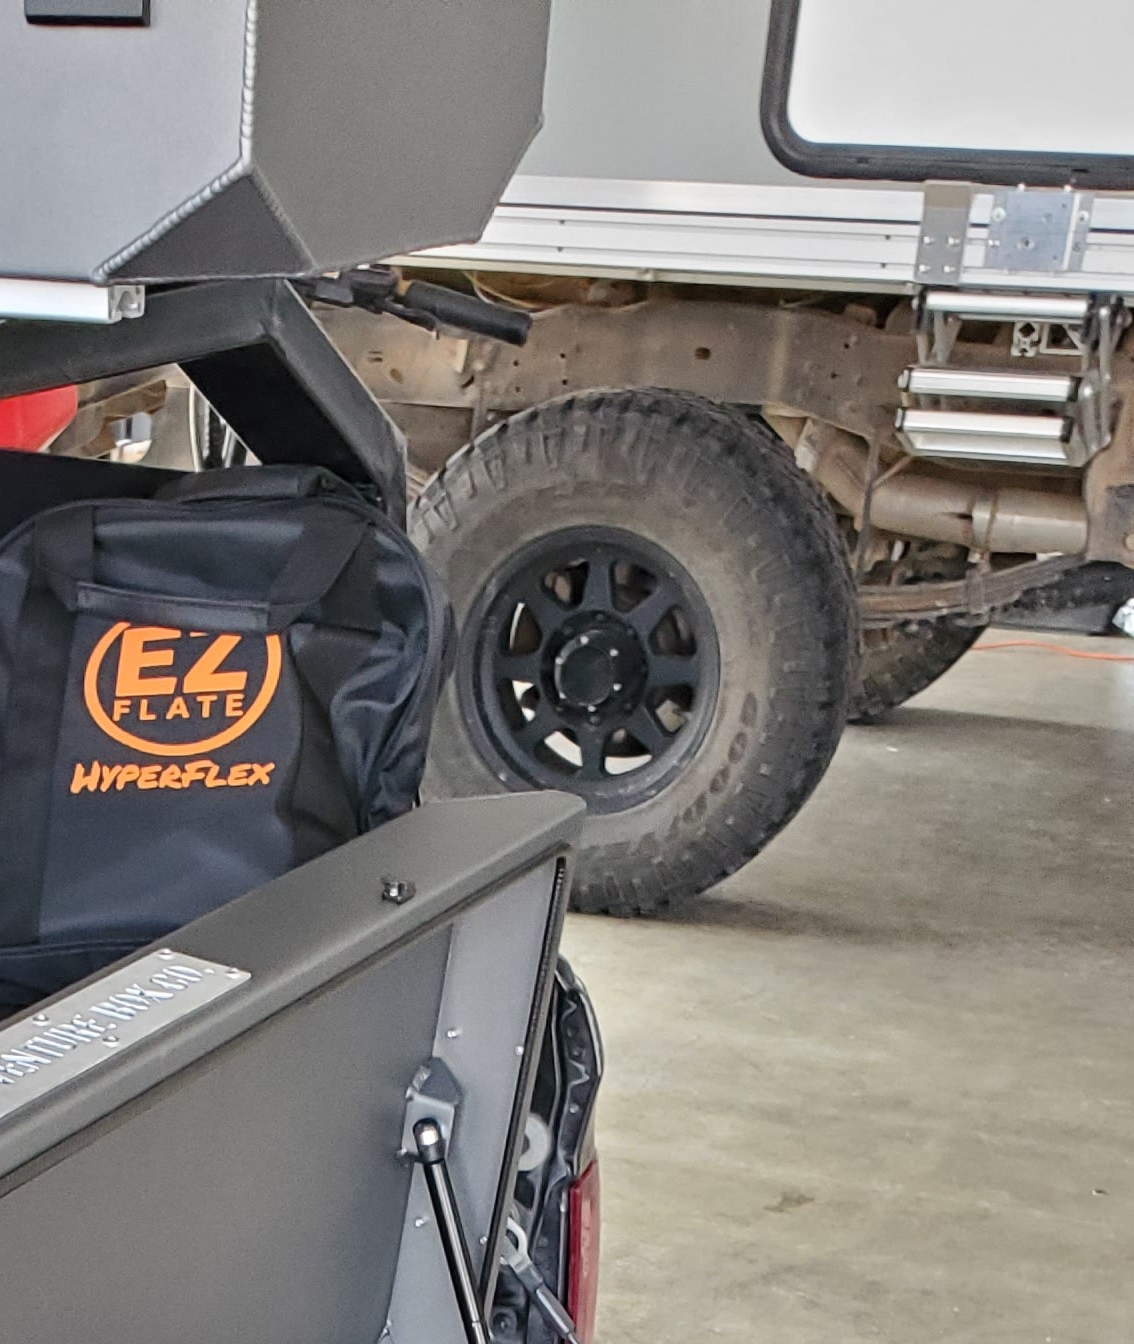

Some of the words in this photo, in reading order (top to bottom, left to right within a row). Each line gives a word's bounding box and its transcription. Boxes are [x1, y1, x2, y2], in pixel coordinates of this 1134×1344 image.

[115, 626, 248, 697] EZ
[112, 693, 245, 722] FLATE
[88, 983, 175, 1021] BOX
